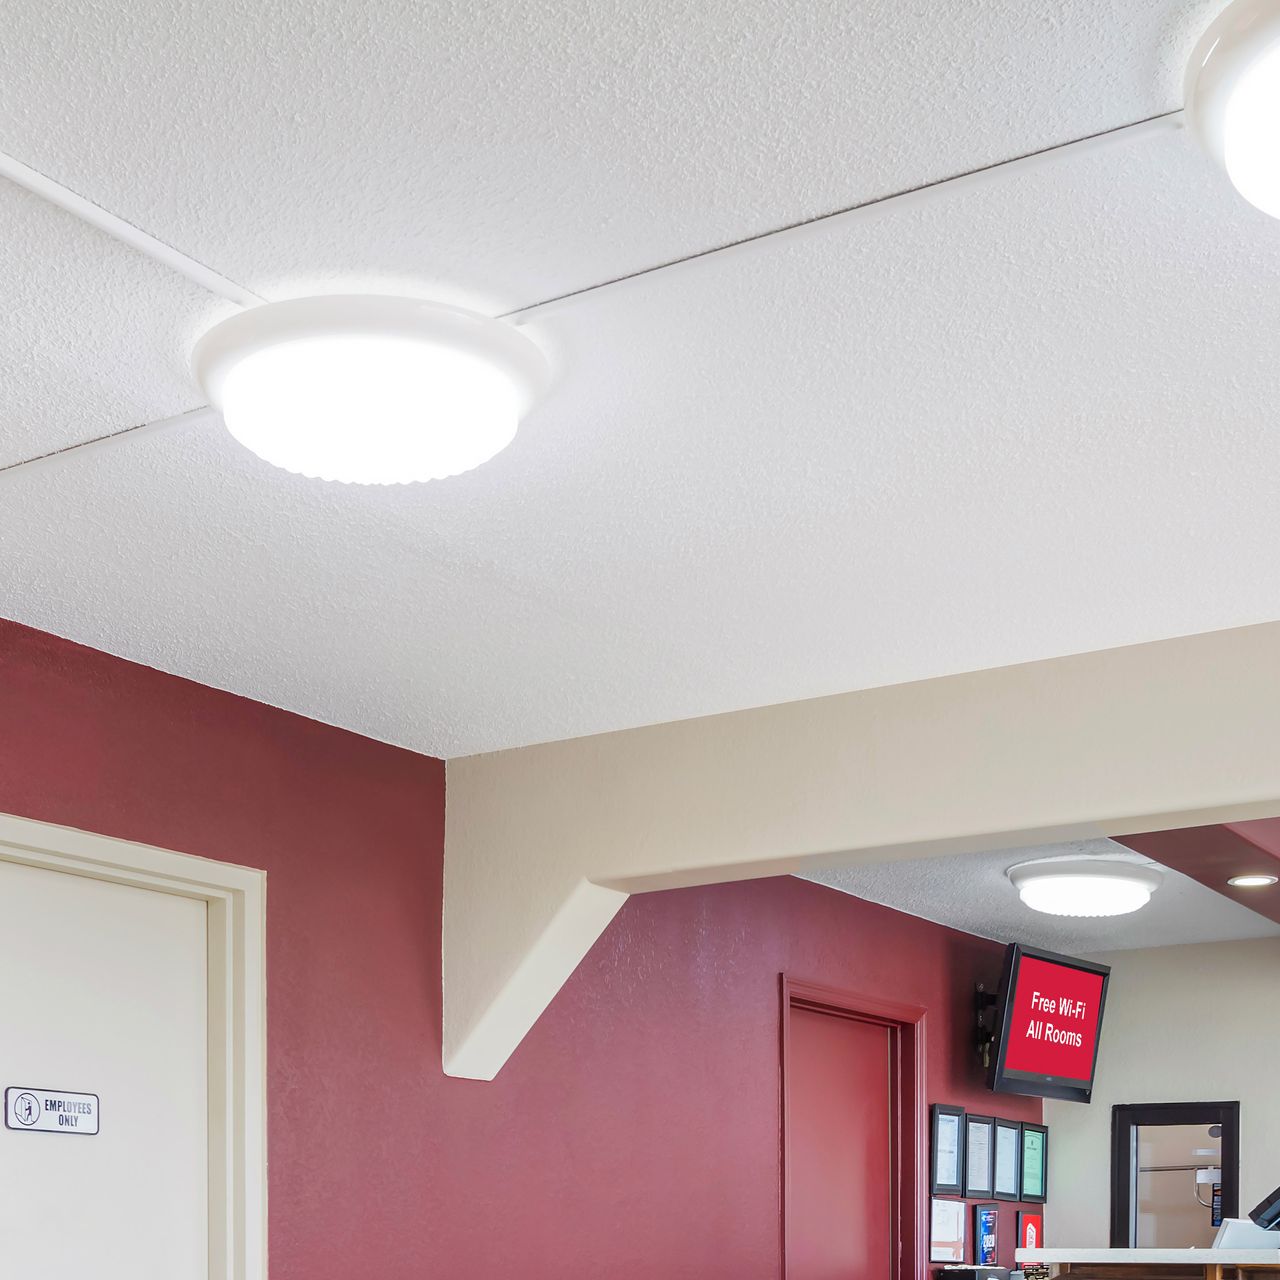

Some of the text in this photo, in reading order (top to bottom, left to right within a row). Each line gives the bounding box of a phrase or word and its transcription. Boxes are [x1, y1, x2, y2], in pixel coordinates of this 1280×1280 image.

[1031, 991, 1086, 1020] Free Wi-Fi
[1025, 1019, 1082, 1048] All Rooms
[44, 1099, 92, 1115] EMPLOYEES
[58, 1114, 79, 1127] ONLY
